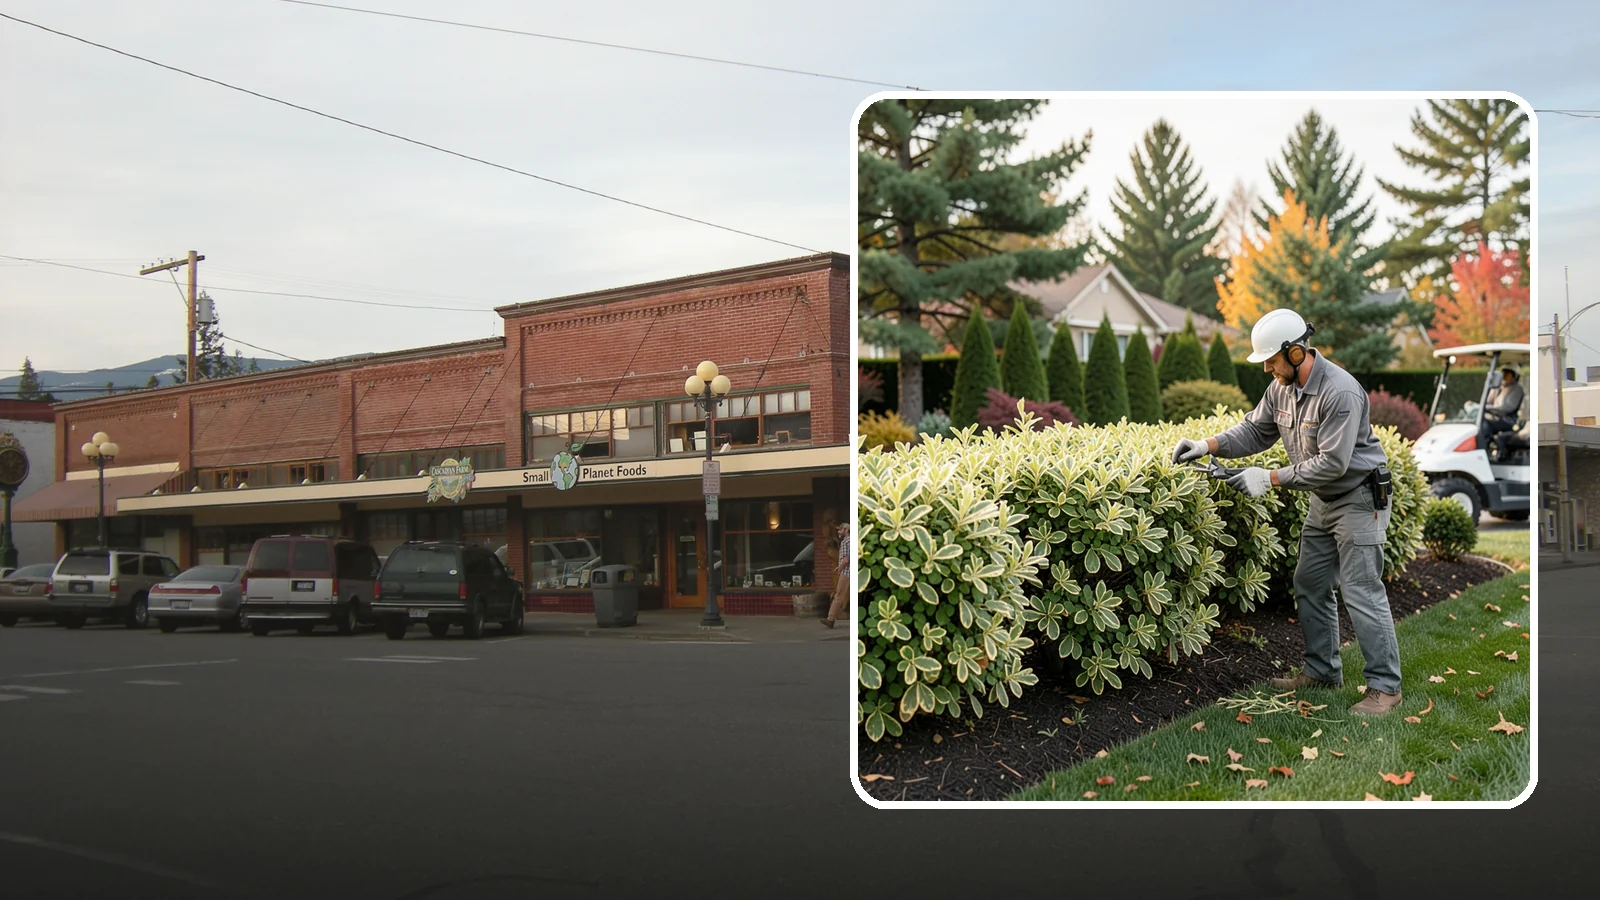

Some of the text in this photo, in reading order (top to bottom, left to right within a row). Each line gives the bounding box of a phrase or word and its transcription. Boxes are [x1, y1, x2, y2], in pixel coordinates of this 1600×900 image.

[523, 464, 647, 483] Small Planet Foods
